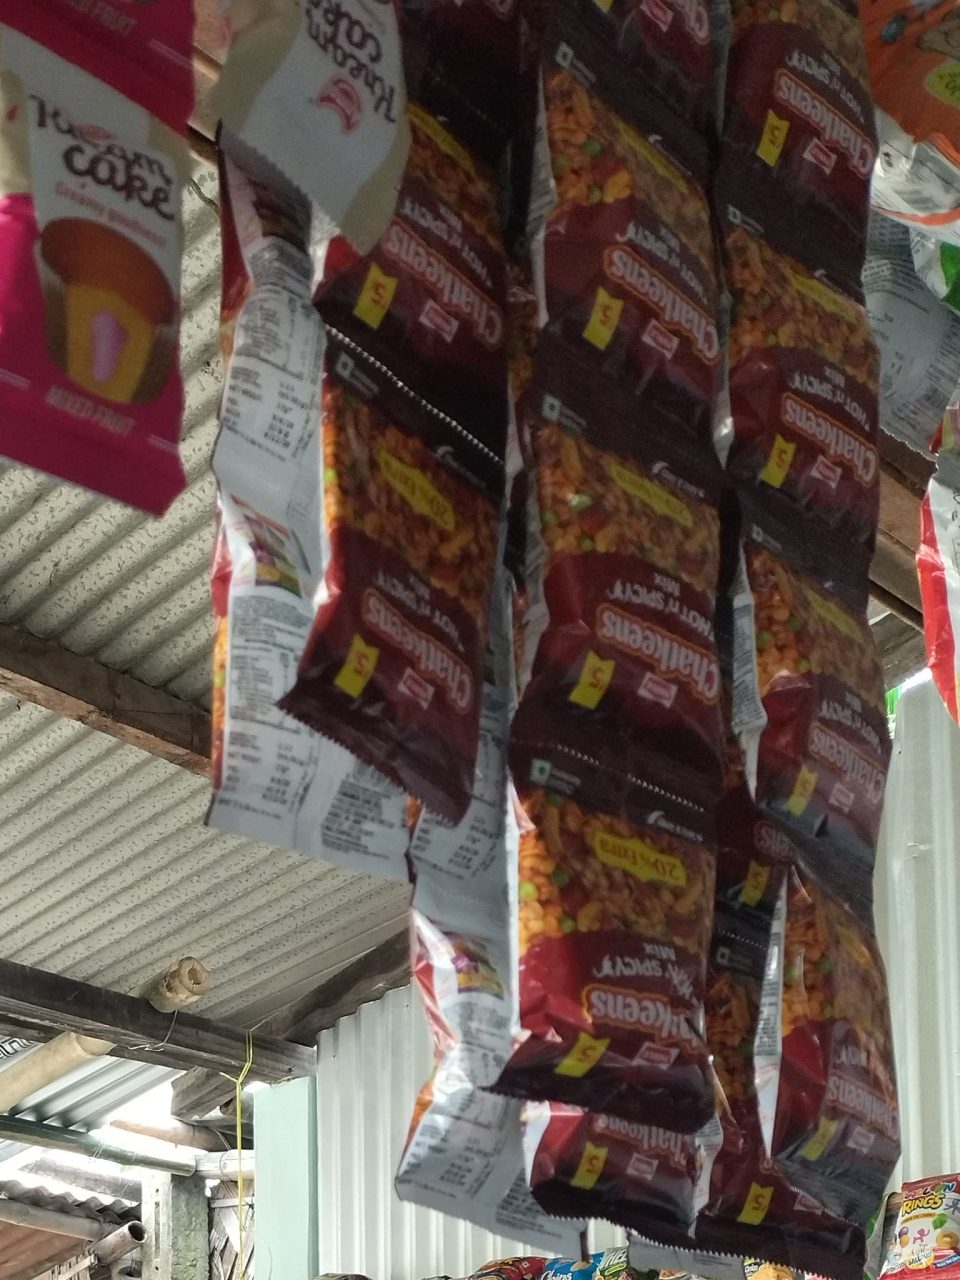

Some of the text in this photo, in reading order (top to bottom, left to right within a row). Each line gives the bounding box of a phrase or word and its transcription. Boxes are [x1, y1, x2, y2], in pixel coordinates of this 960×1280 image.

[62, 144, 176, 222] cake
[610, 249, 719, 359] Chatkeens
[784, 400, 877, 482] Chatkeens
[601, 609, 721, 699] Chatkeens
[901, 1192, 946, 1217] RINGS
